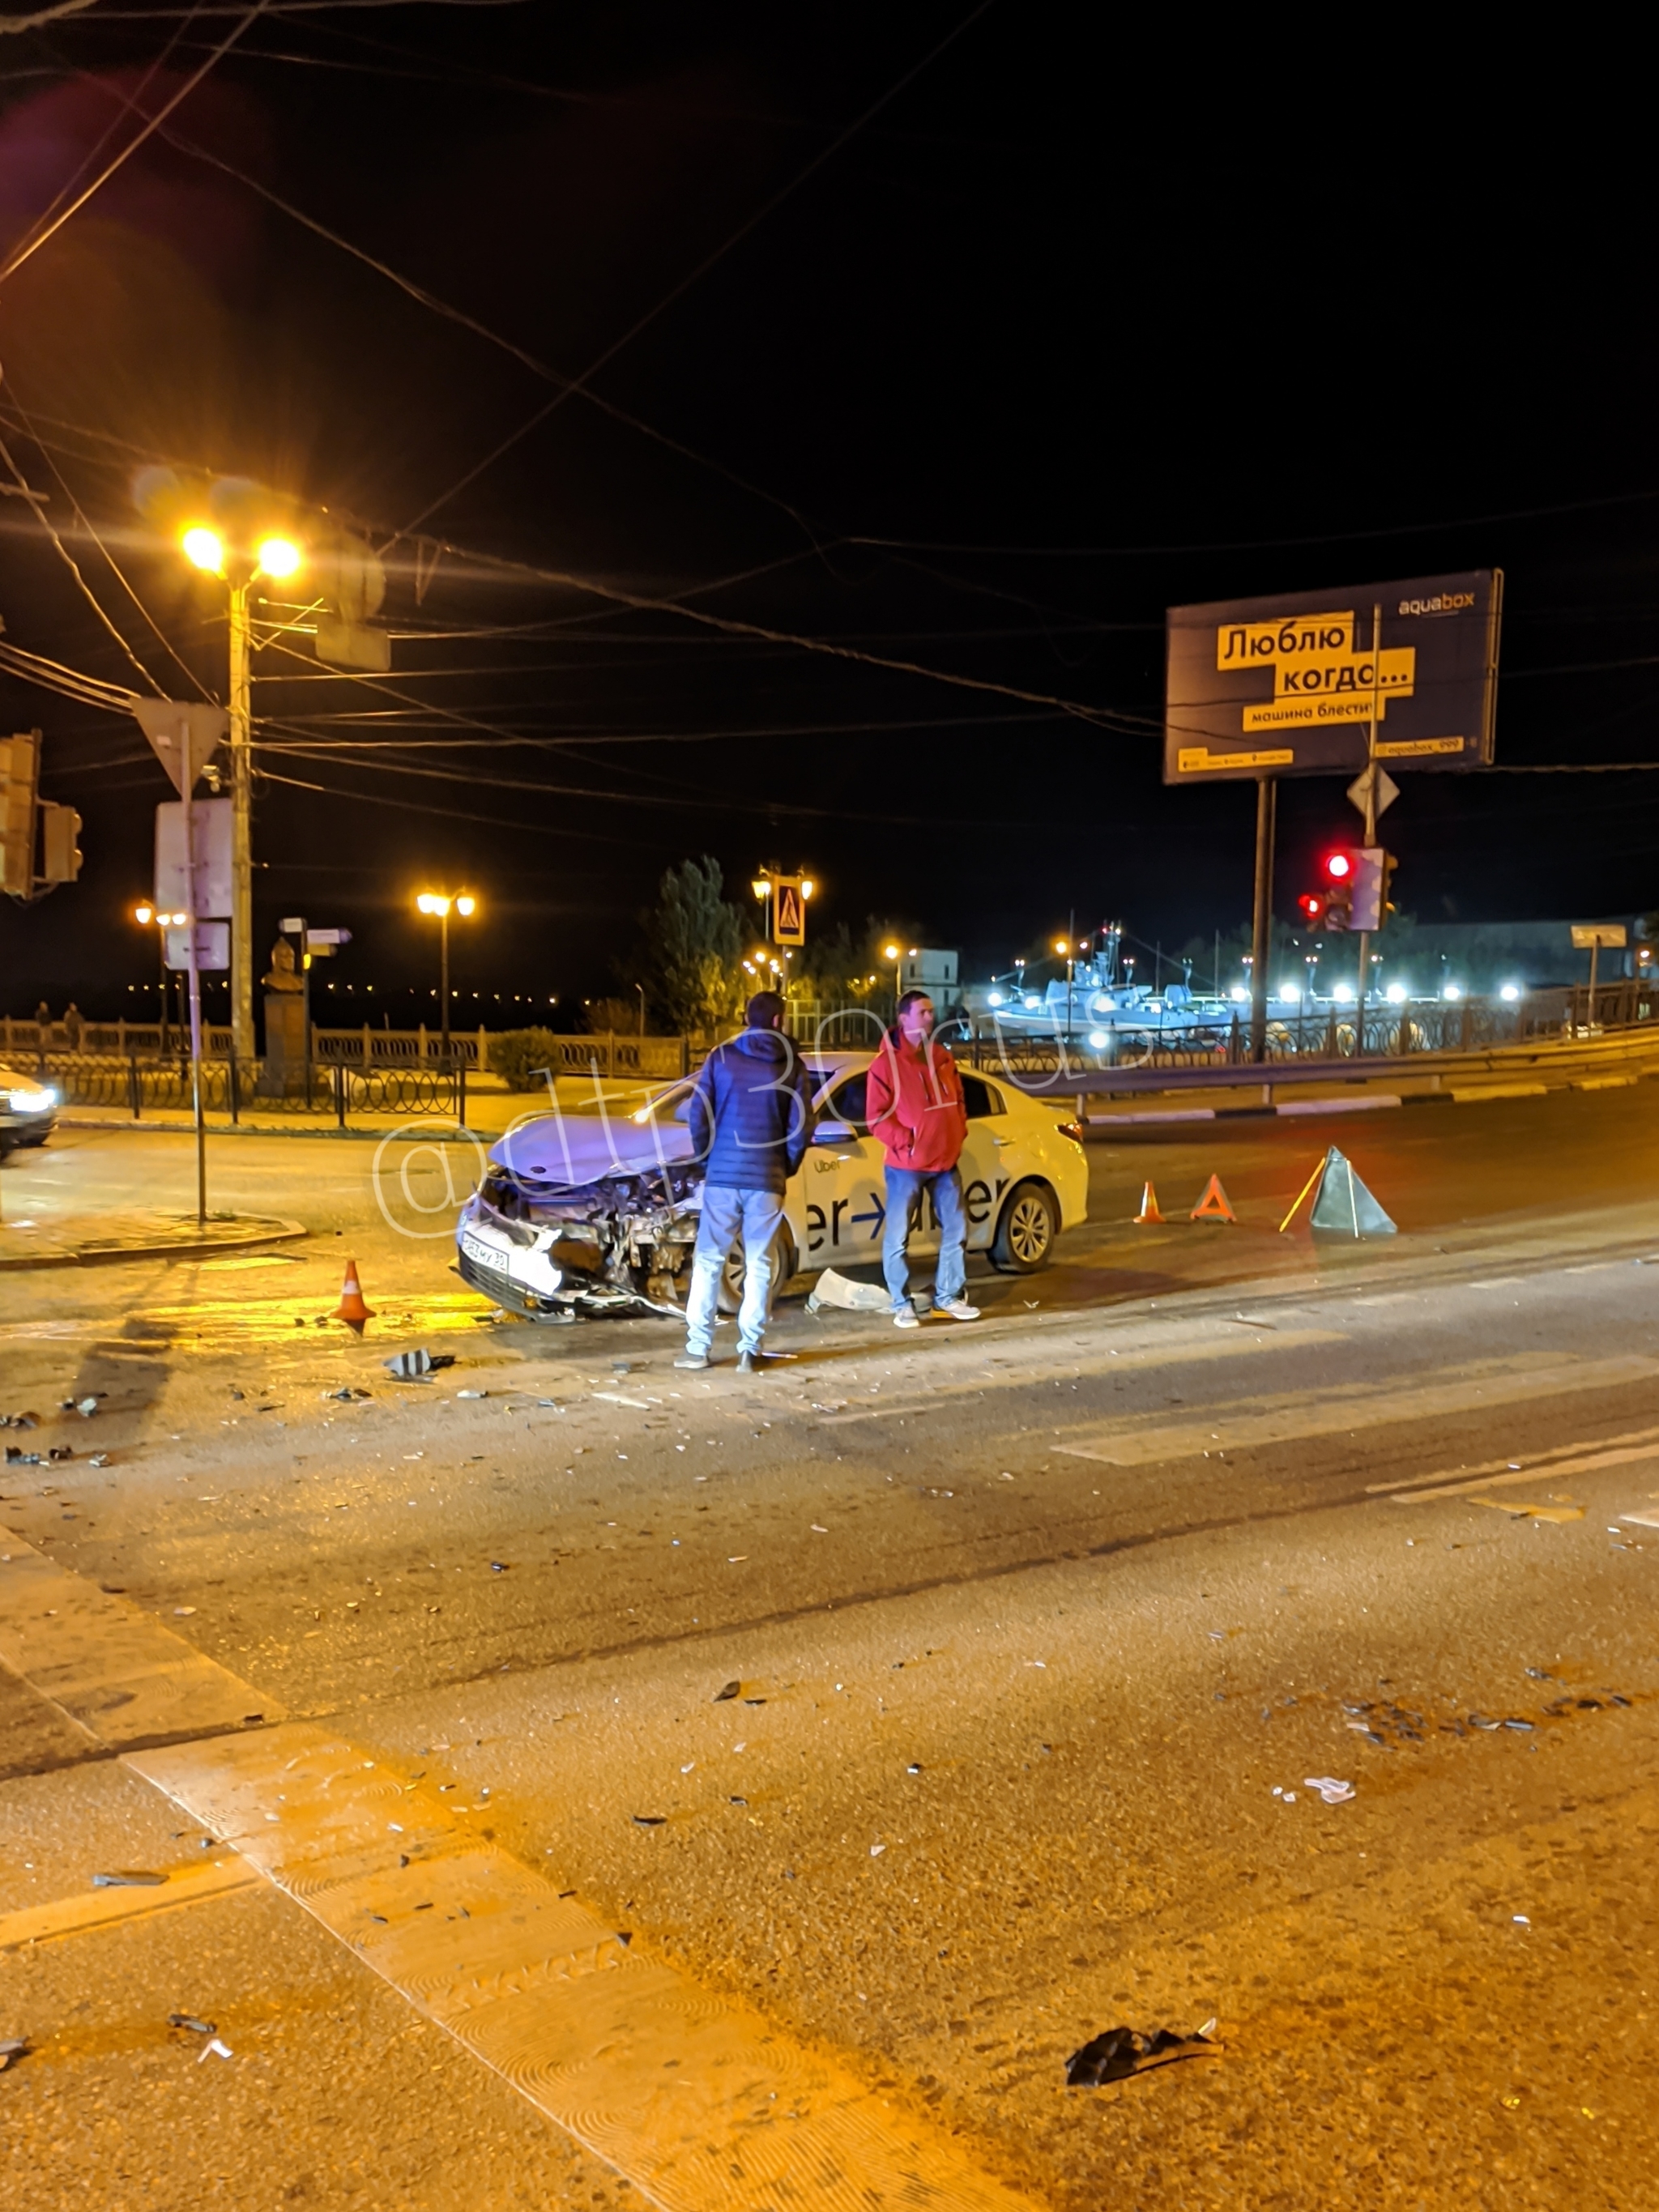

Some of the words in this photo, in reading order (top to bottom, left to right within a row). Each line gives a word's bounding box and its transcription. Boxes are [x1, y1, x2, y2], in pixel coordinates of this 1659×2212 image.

[1398, 593, 1474, 615] aquabox
[1224, 620, 1345, 659] Люблю
[1252, 707, 1313, 723] машина
